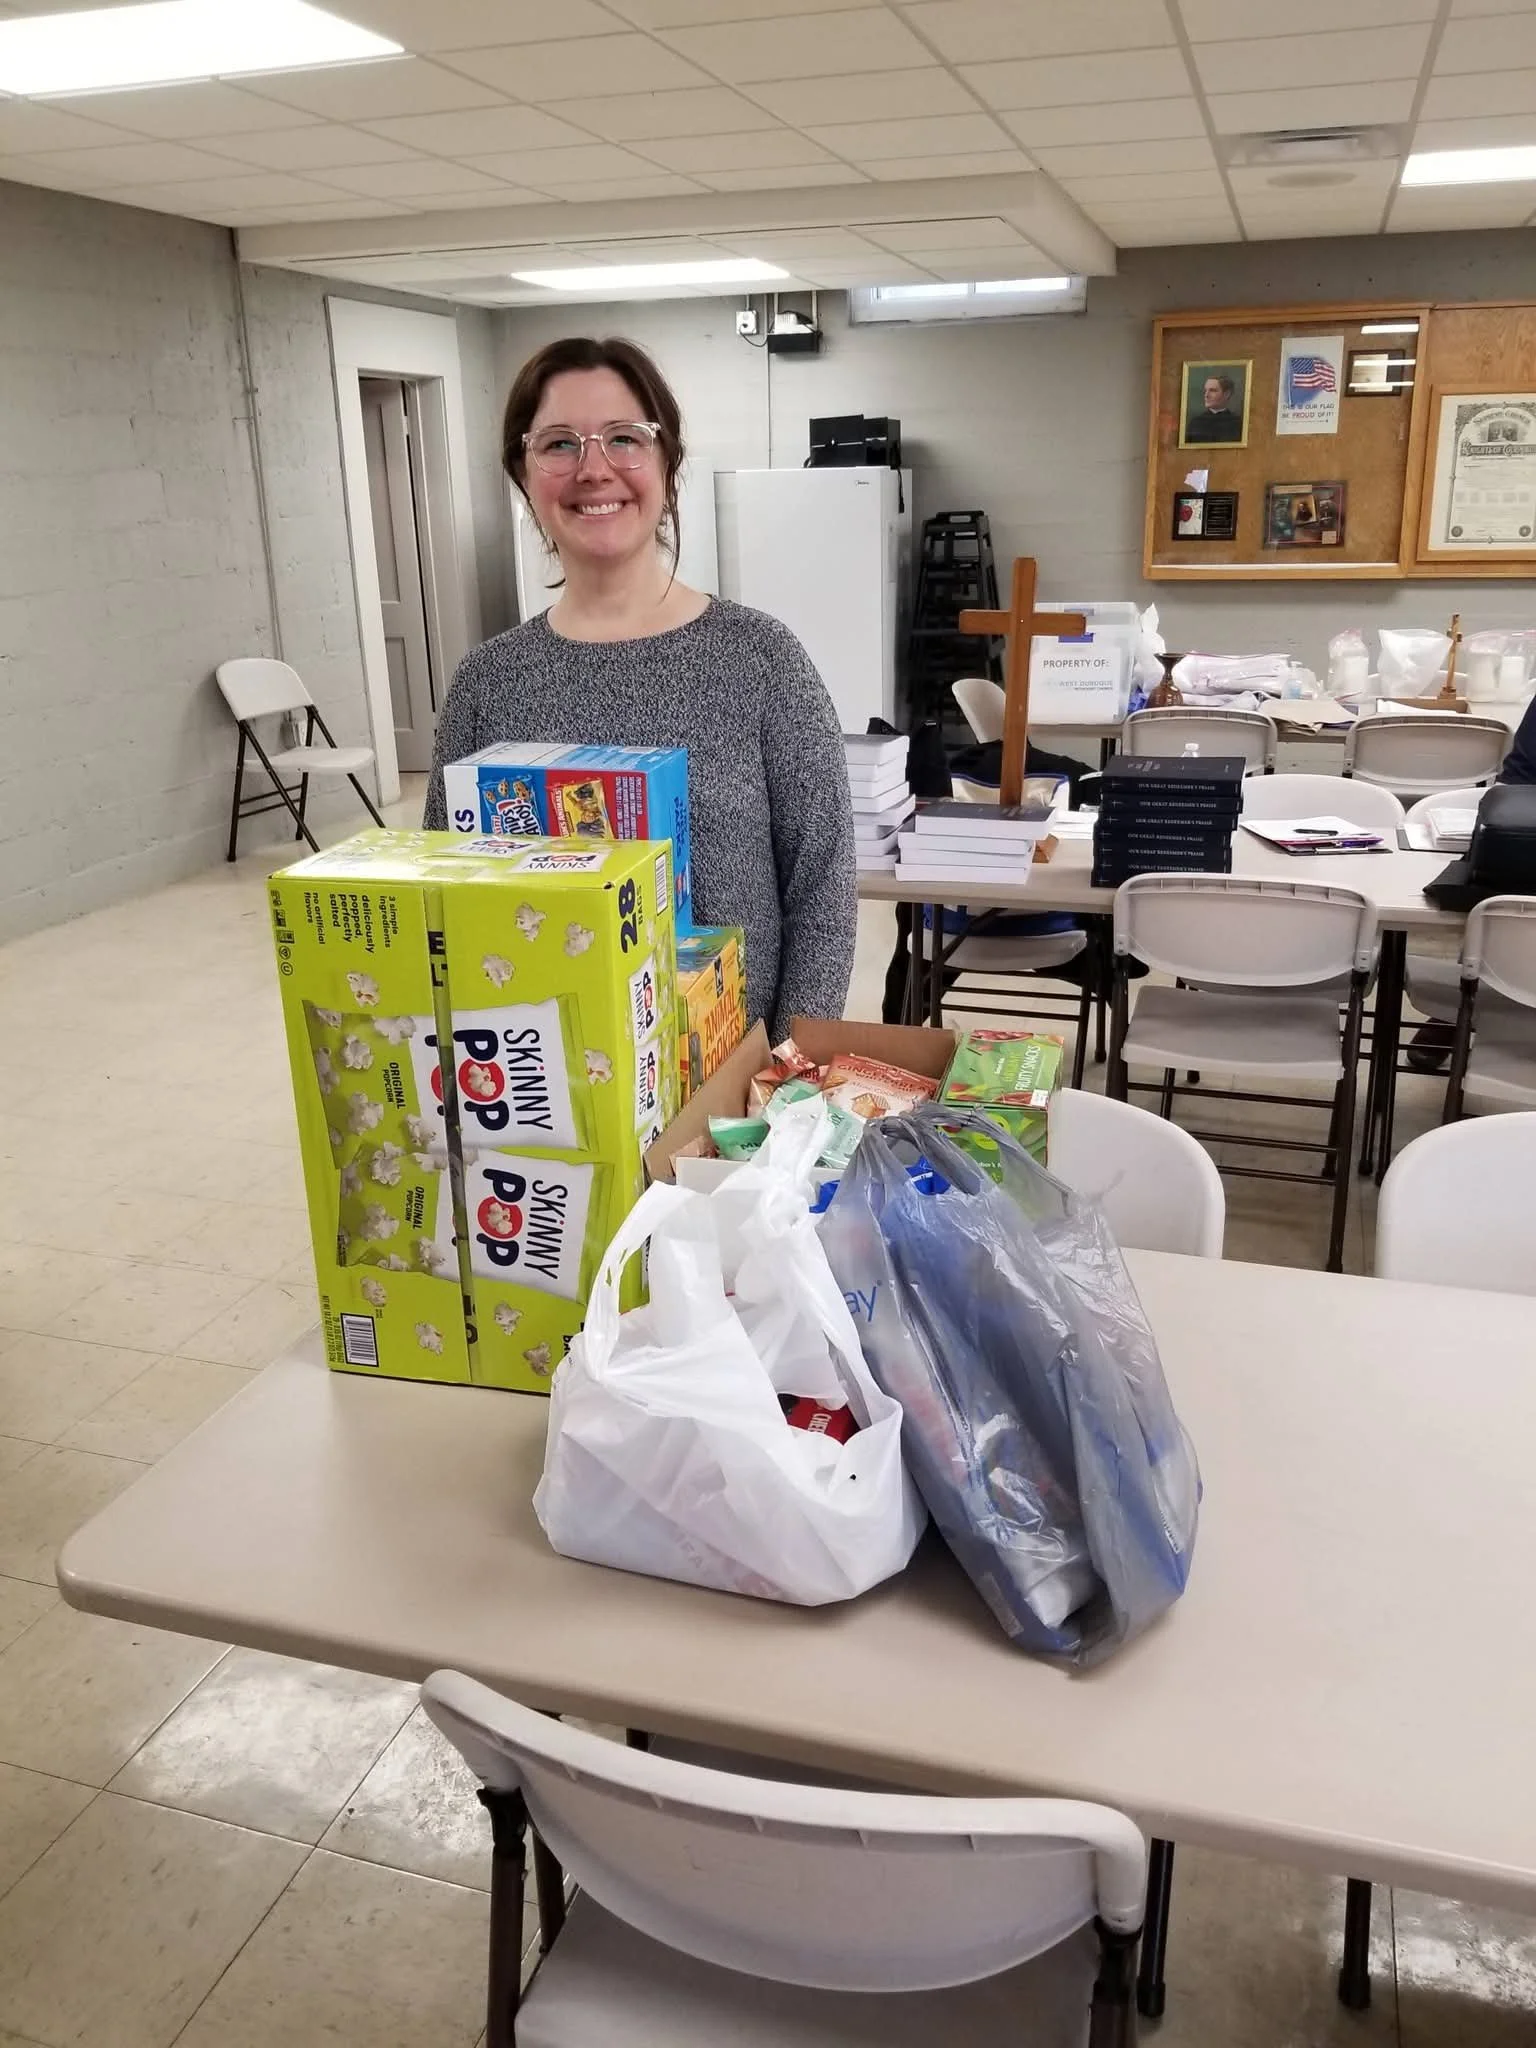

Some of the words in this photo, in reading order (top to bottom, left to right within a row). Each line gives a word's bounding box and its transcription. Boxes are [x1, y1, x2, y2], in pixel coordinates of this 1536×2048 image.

[1043, 659, 1091, 668] PROPERTY
[1093, 658, 1110, 668] OF:
[503, 808, 523, 835] hips
[303, 892, 313, 923] flavors
[312, 892, 319, 905] no
[329, 893, 341, 928] salted
[338, 893, 352, 943] perfectly
[349, 894, 363, 939] popped,
[379, 895, 391, 948] ingredients
[388, 903, 399, 935] simple
[618, 878, 638, 953] 28
[315, 905, 326, 945] artificial
[361, 895, 375, 954] deliciously
[633, 981, 646, 1040] SKINNY
[642, 971, 654, 1029] POP
[705, 984, 737, 1050] ANIMAL
[703, 1012, 740, 1081] COOKIES
[382, 1069, 394, 1103] POPCORN
[389, 1062, 406, 1109] ORIGINAL
[453, 1029, 510, 1131] POP
[639, 1056, 647, 1116] SKINNY
[647, 1050, 656, 1110] POP
[405, 1190, 414, 1223] POPCORN
[413, 1186, 425, 1230] ORIGINAL
[476, 1168, 527, 1267] POP
